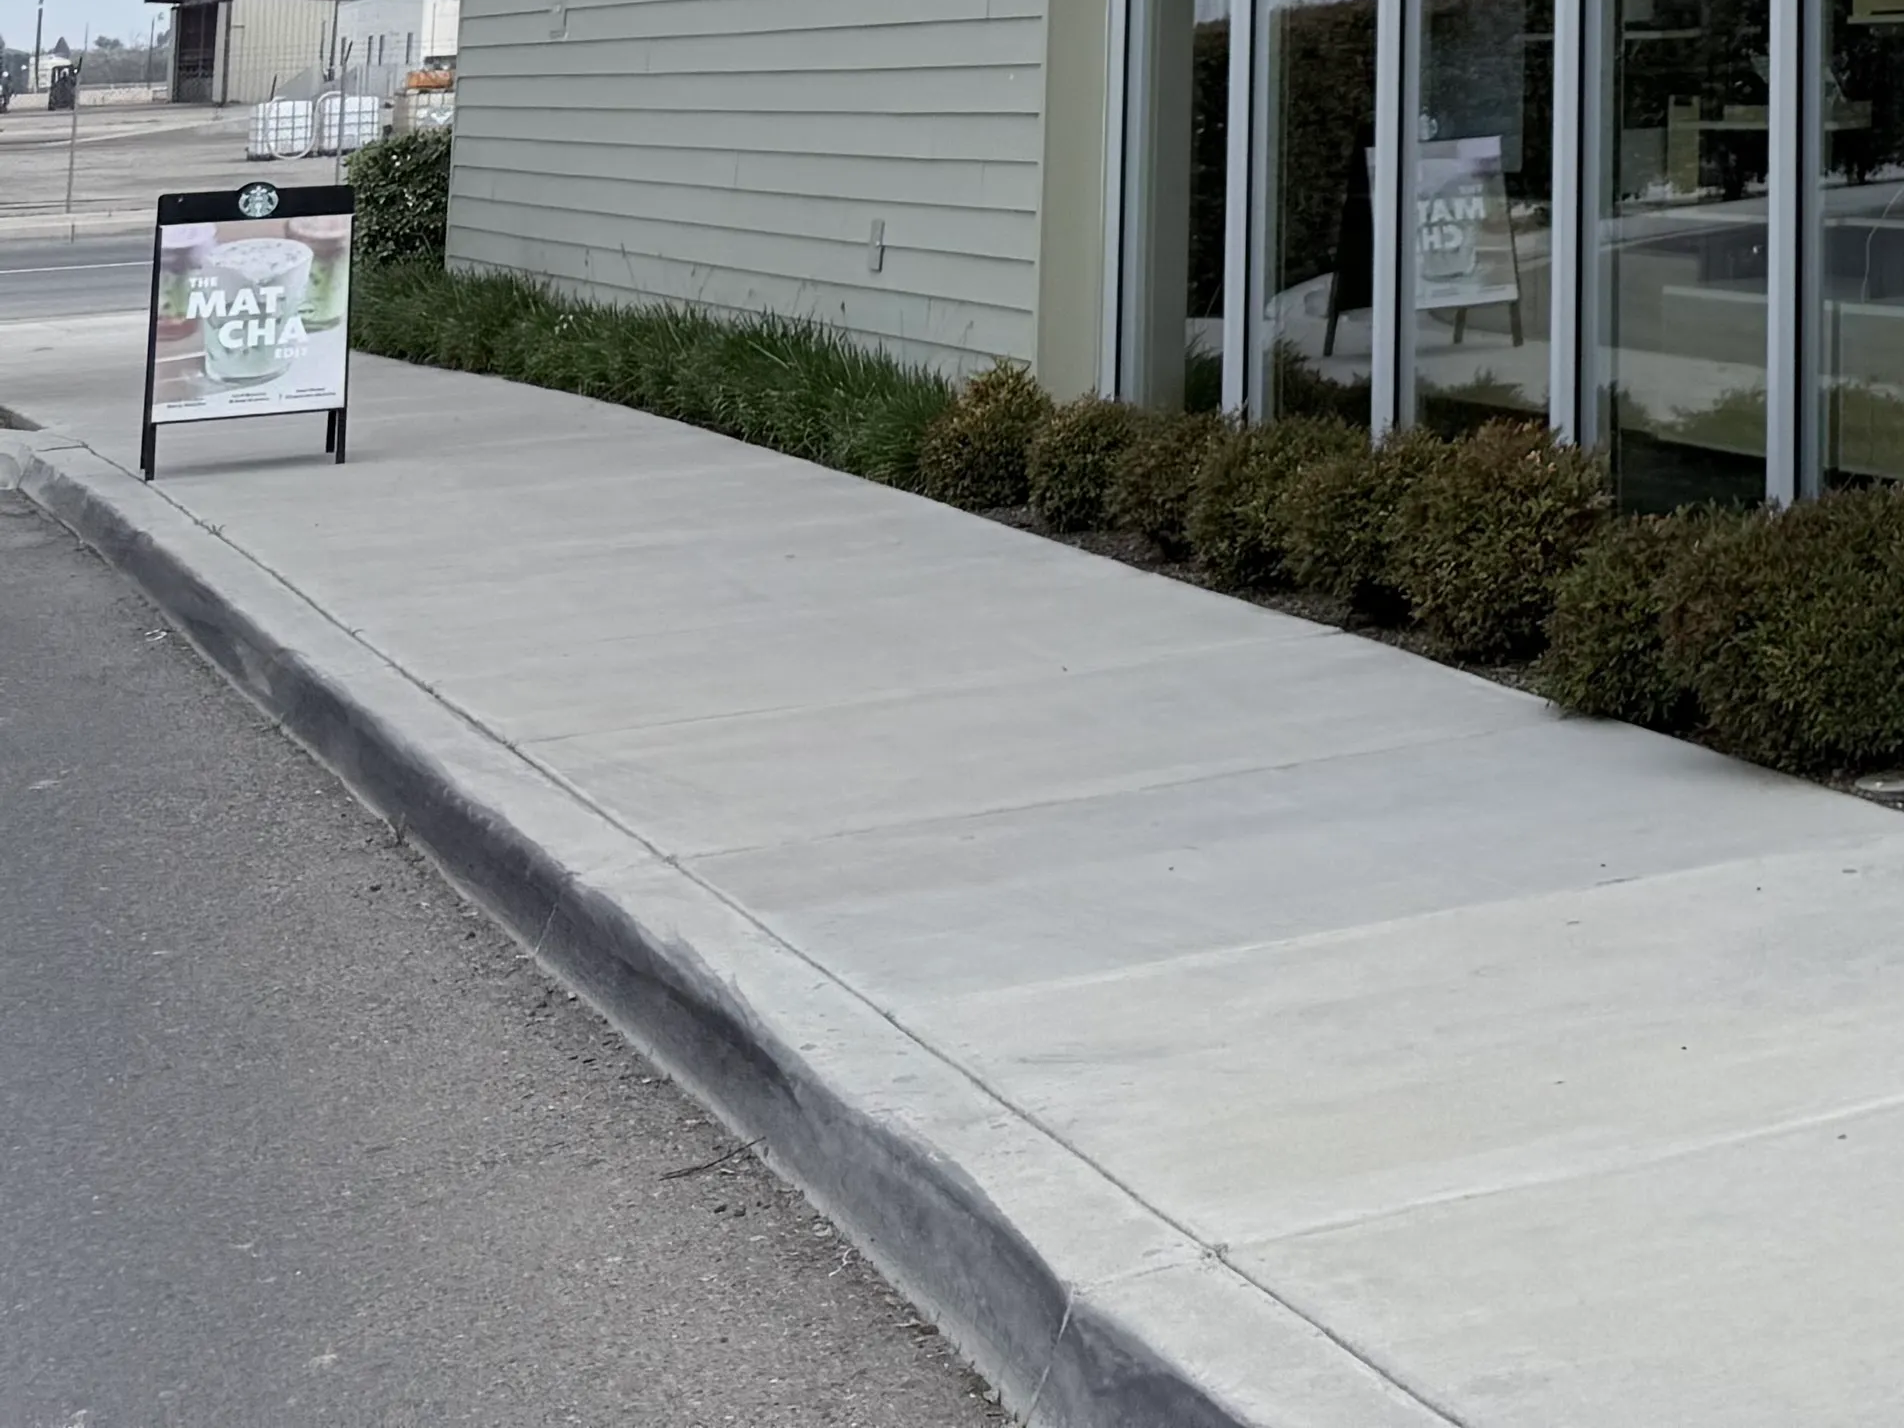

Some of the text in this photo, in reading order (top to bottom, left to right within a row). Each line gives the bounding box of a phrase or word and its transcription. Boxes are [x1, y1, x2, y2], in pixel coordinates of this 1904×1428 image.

[188, 276, 218, 288] THE
[186, 286, 284, 320] MAT
[218, 315, 309, 349] CHA
